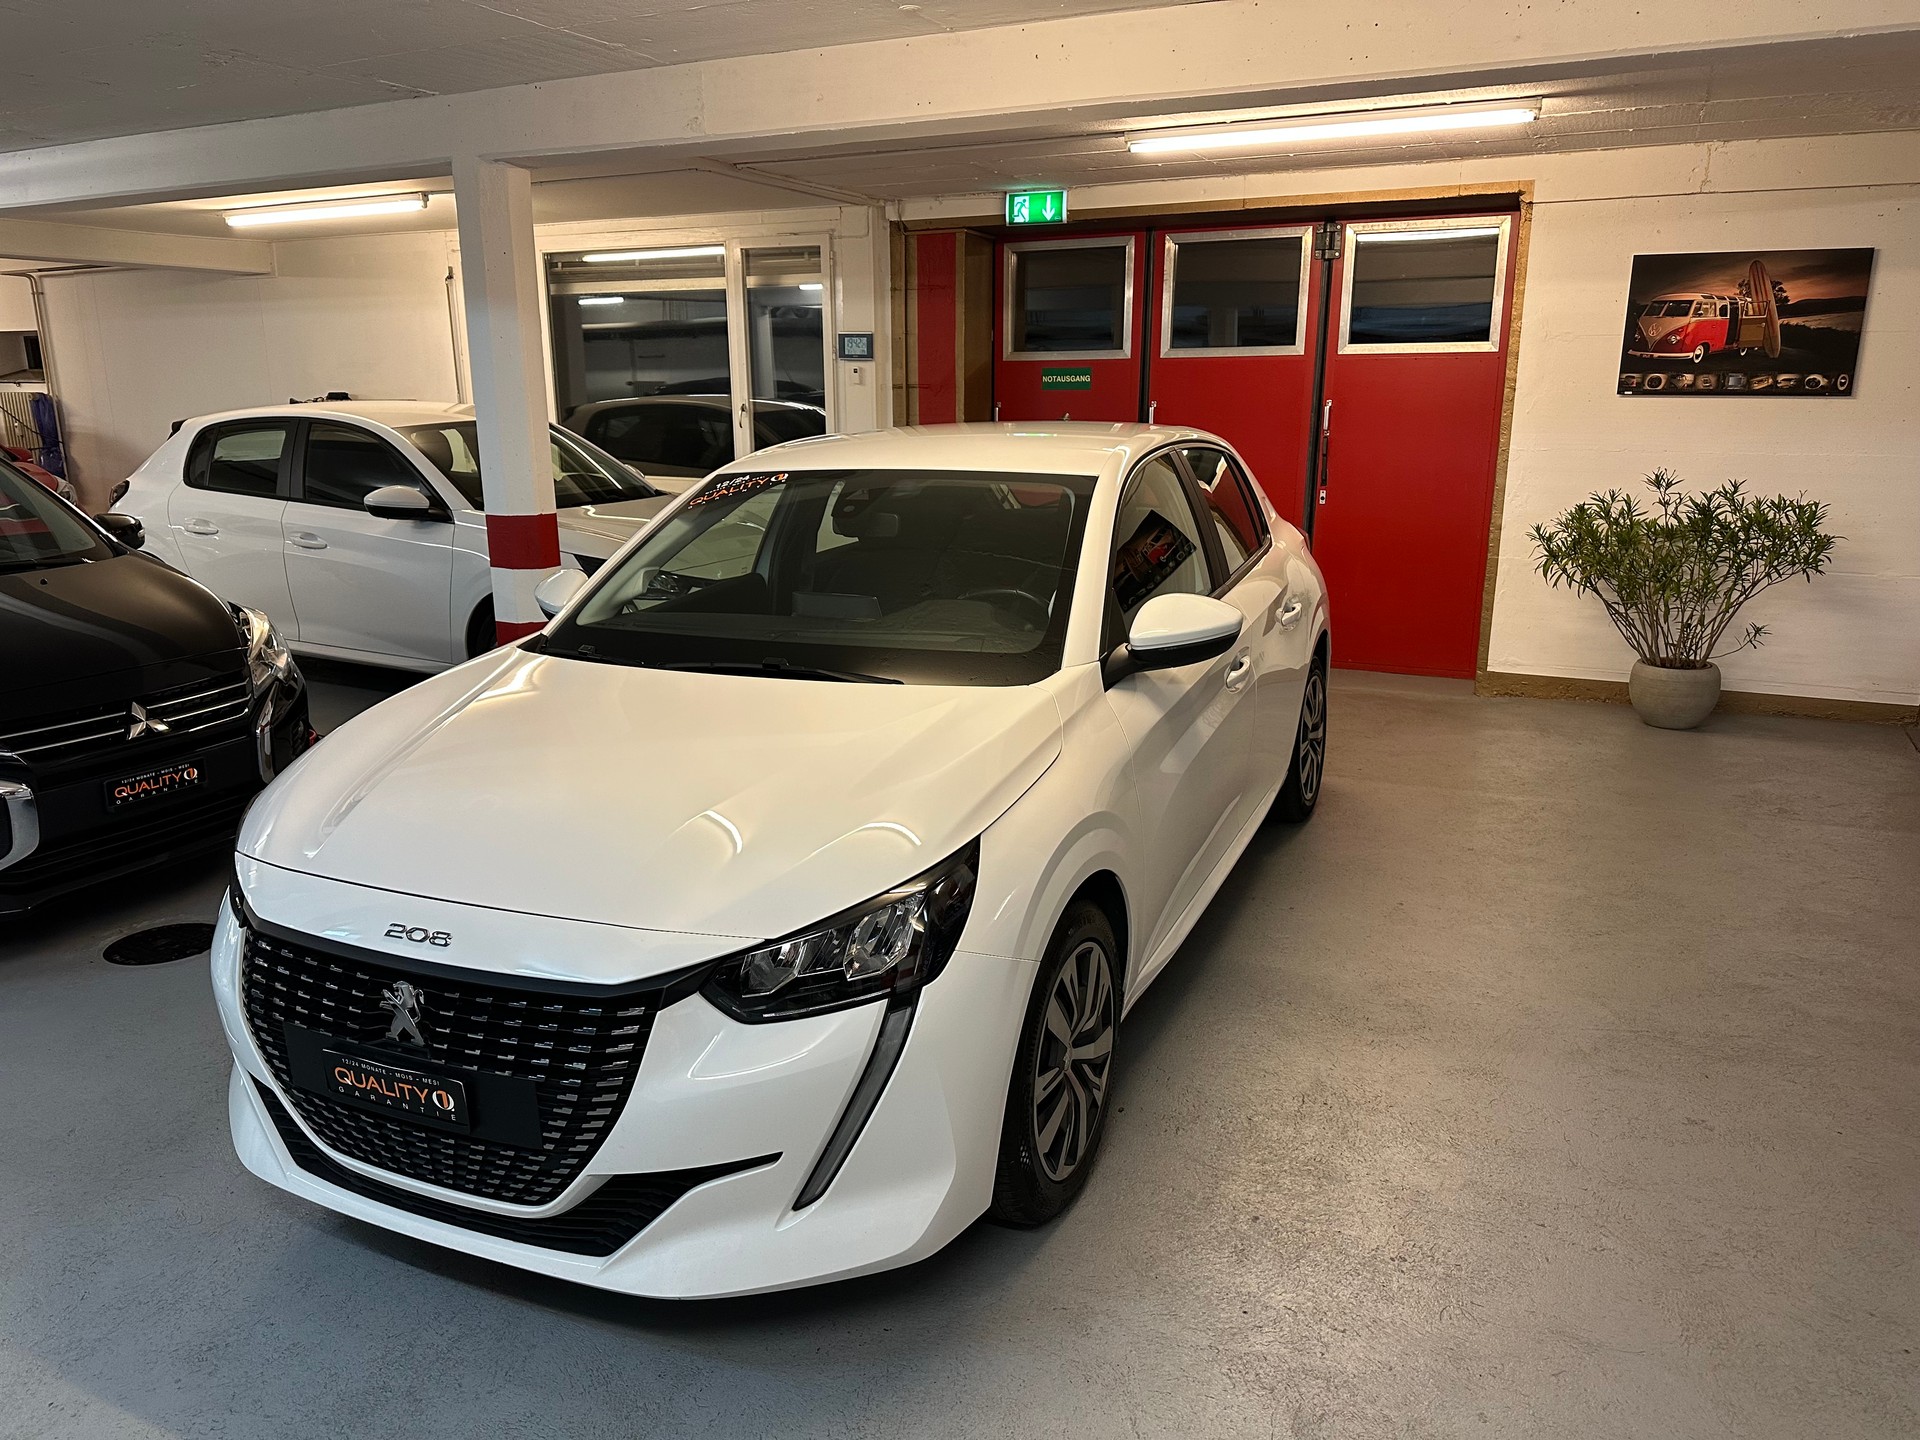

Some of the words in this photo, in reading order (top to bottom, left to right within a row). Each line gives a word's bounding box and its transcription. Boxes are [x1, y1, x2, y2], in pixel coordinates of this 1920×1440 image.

[690, 477, 769, 506] QUALITY
[114, 771, 182, 798] QUALITY
[384, 922, 453, 947] 208
[334, 1067, 428, 1104] QUALITY
[341, 1058, 359, 1067] 12/24
[361, 1063, 387, 1075] MONATE
[395, 1072, 413, 1081] MOIS
[422, 1077, 440, 1087] MESI
[338, 1086, 456, 1121] GARANTIE
